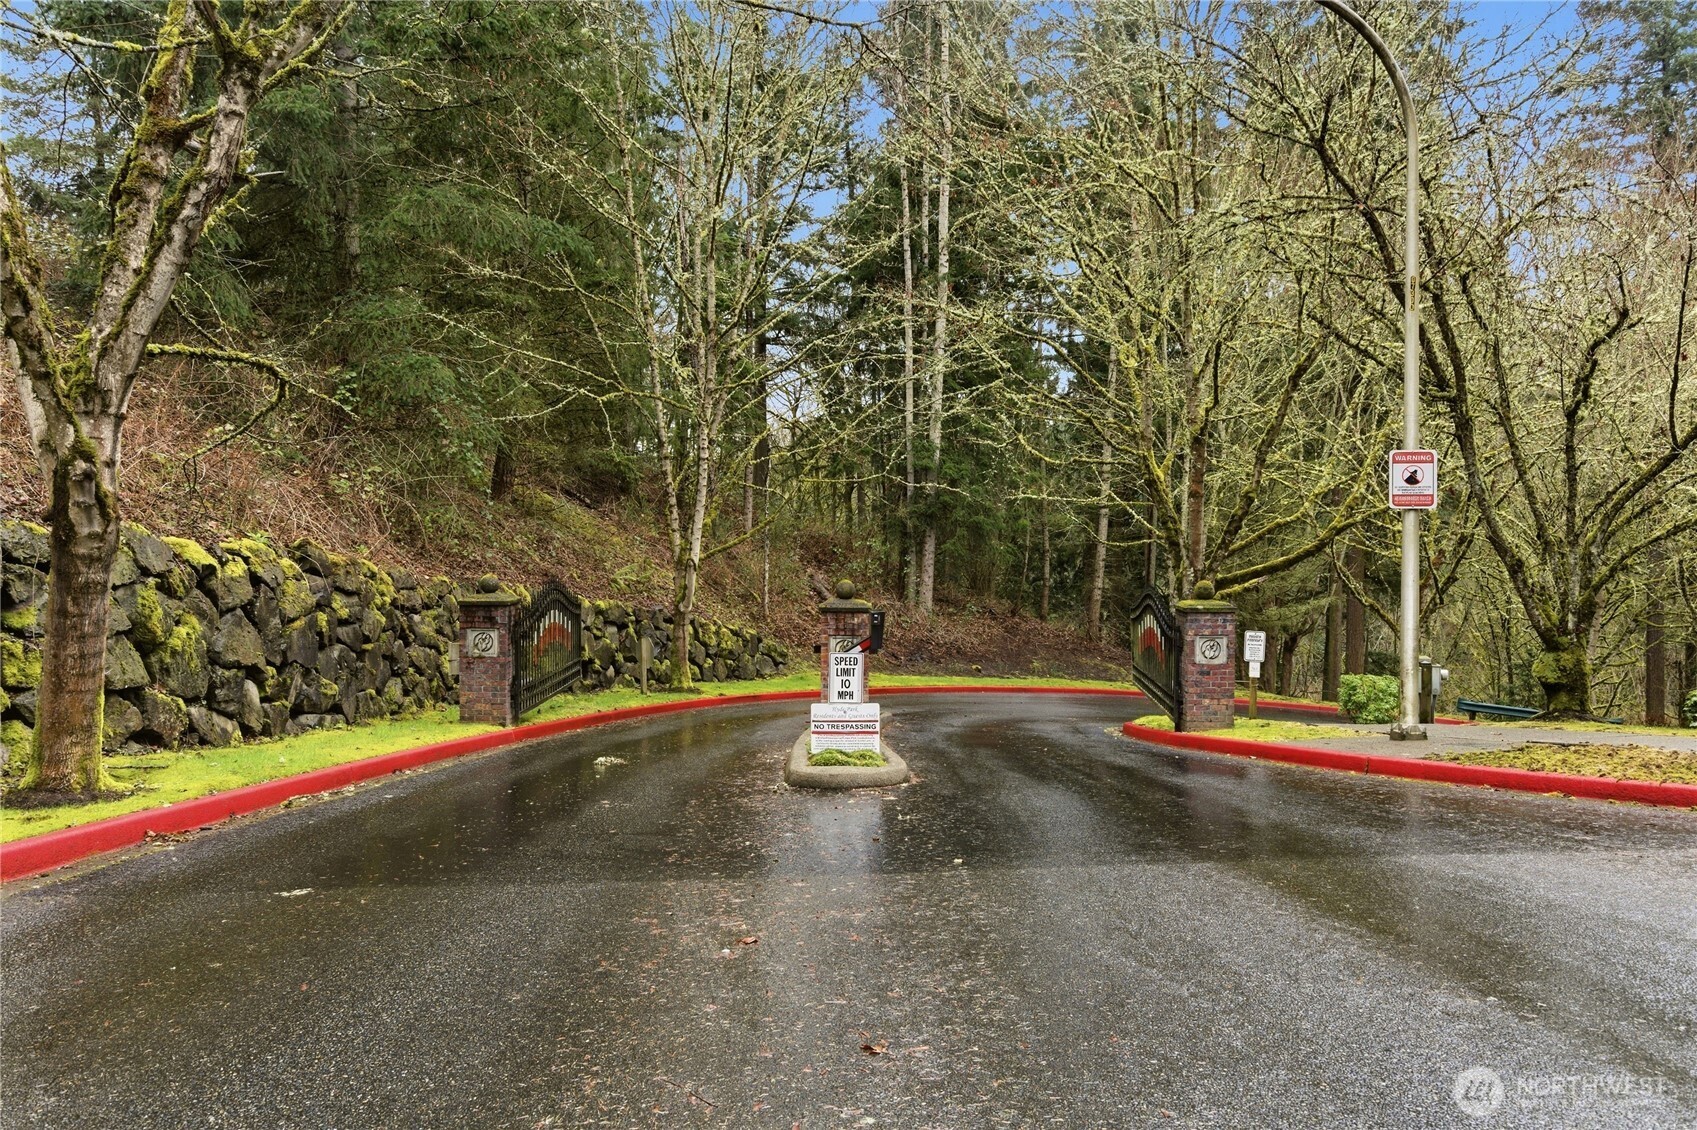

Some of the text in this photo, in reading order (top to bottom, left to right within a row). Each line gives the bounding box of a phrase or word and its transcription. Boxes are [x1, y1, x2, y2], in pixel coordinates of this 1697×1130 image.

[834, 656, 858, 666] SPEED
[836, 667, 856, 677] LIMIT
[841, 679, 851, 689] 10
[837, 690, 854, 700] MPH
